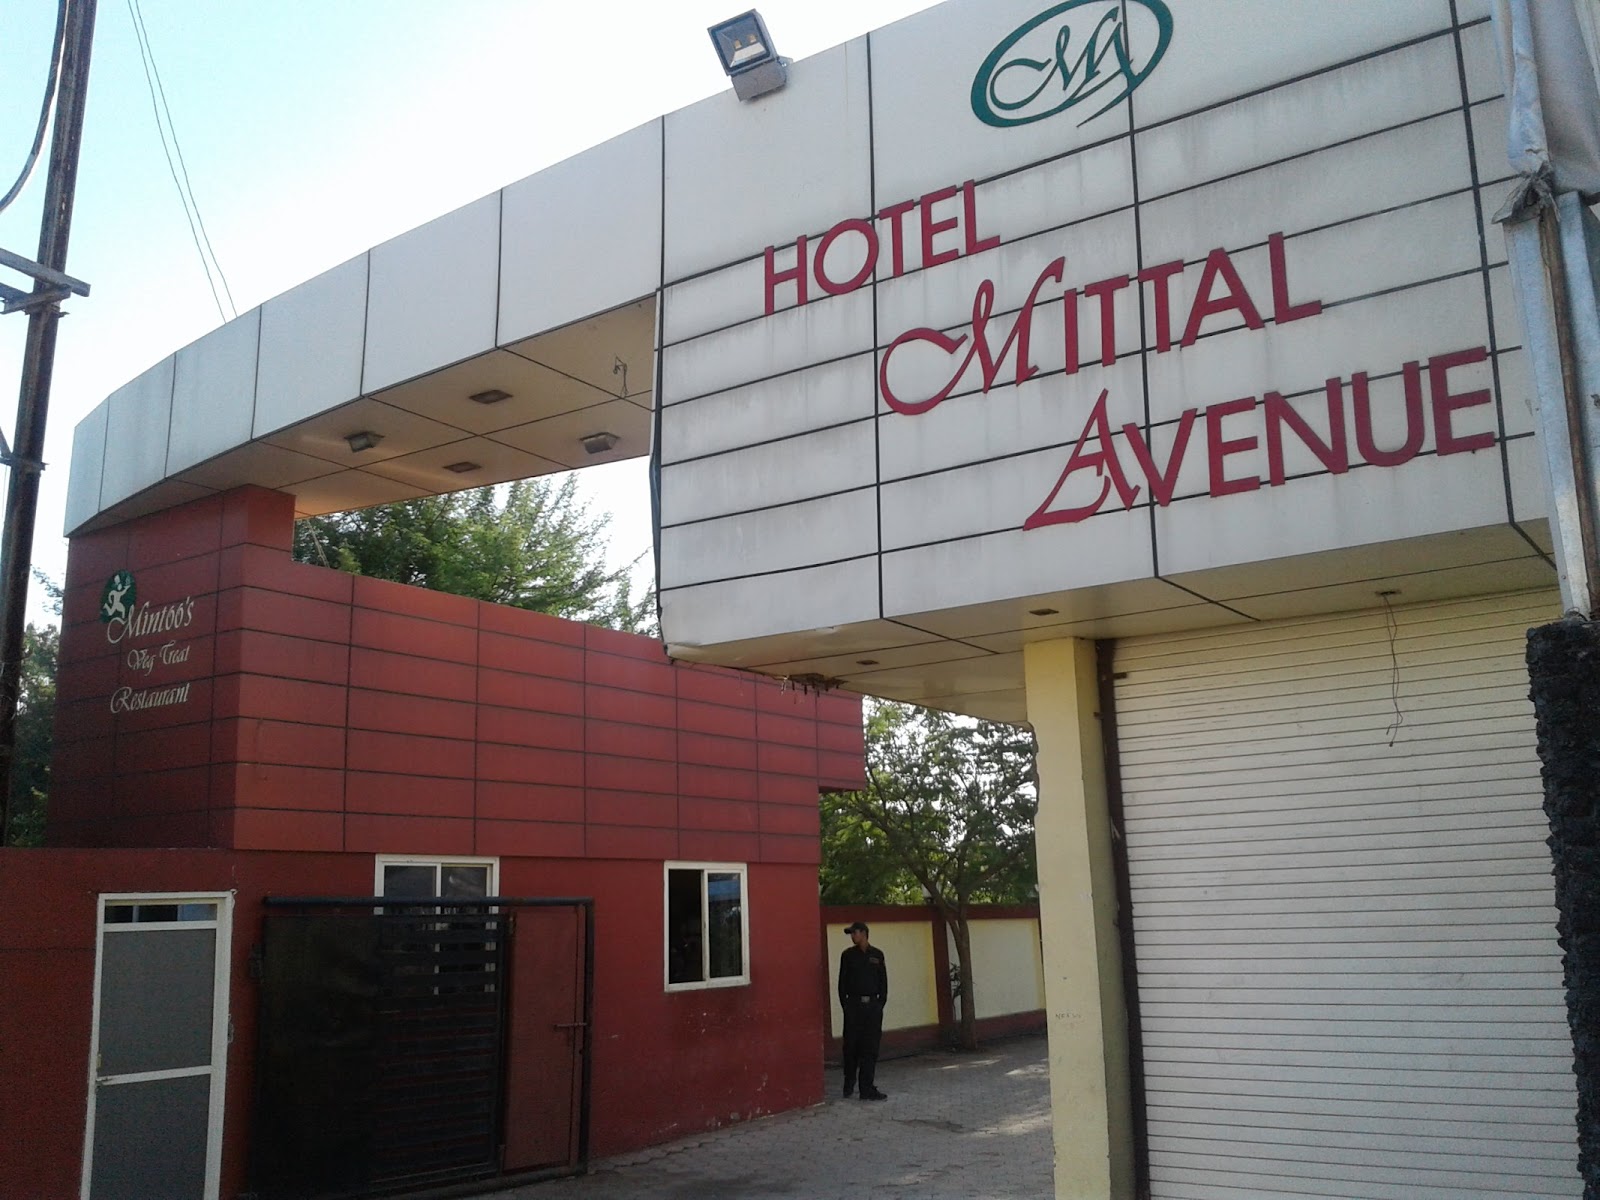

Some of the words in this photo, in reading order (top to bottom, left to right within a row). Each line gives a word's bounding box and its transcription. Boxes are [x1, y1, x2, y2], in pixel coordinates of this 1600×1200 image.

[764, 180, 1000, 315] HOTEL
[879, 232, 1322, 415] MITTAL
[1023, 346, 1496, 530] AVENUE
[107, 596, 194, 643] Mintoo's
[128, 649, 156, 676] Veg
[160, 640, 190, 665] Treat
[111, 683, 190, 713] Restaurant
